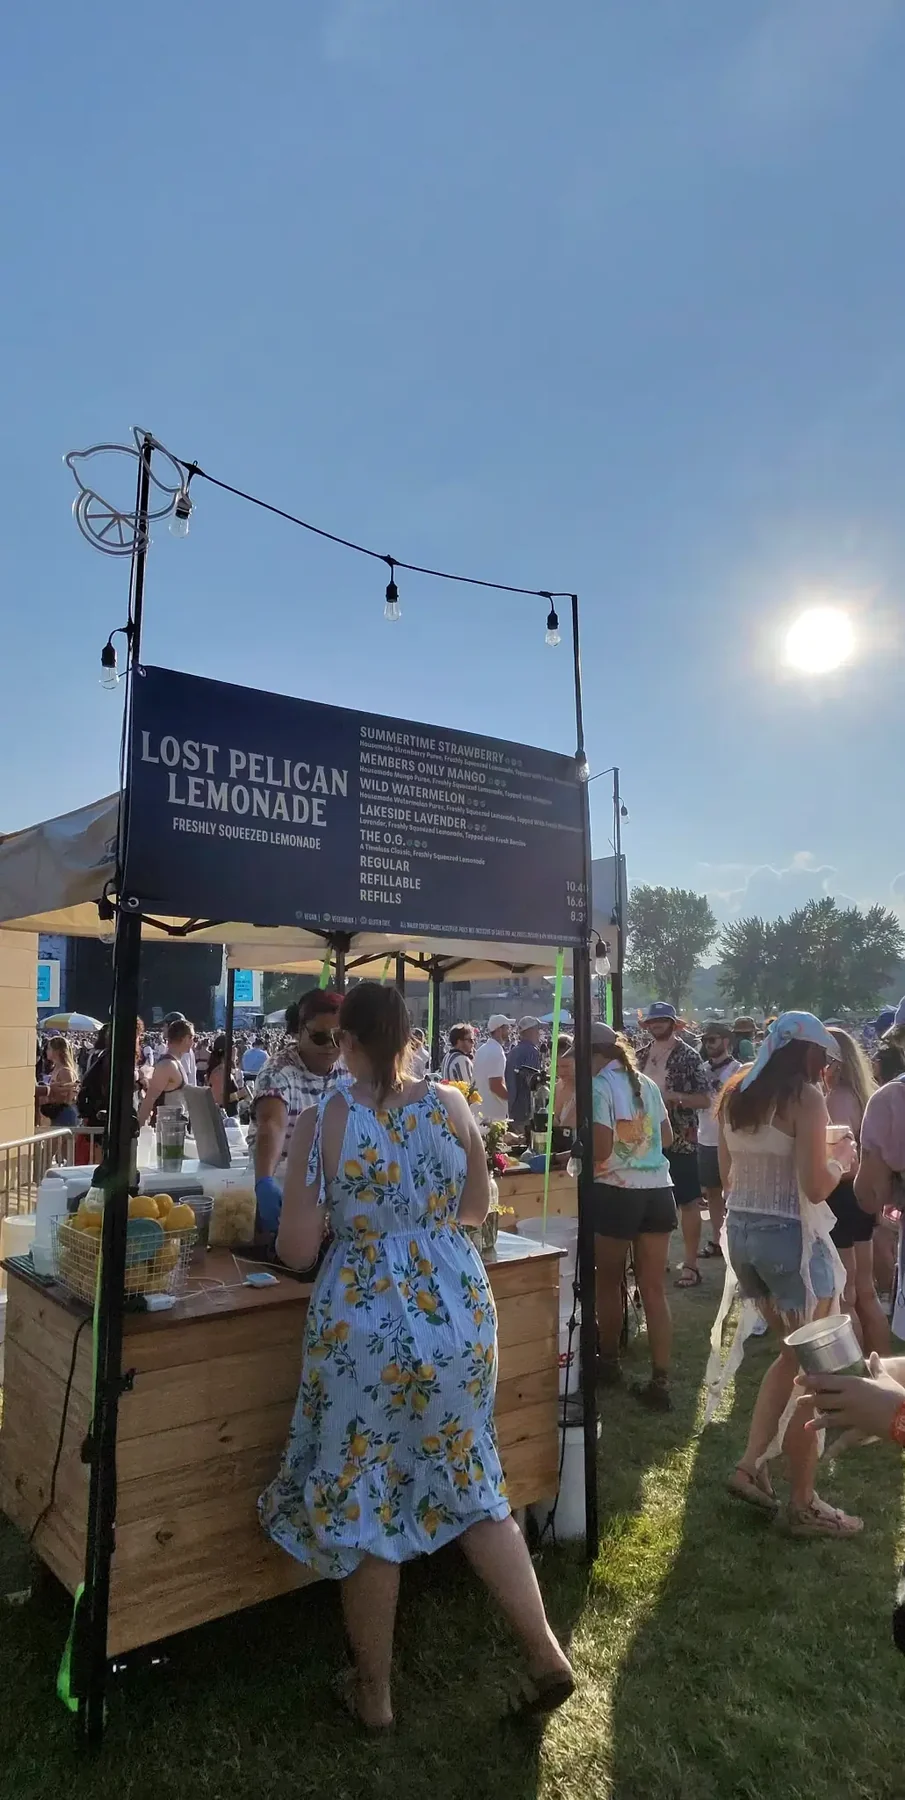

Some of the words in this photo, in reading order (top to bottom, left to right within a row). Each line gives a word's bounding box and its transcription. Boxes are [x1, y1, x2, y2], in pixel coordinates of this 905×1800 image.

[360, 726, 436, 750] SUMMERTIME
[438, 740, 504, 764] STRAWBERRY
[140, 730, 219, 775] LOST
[228, 748, 349, 797] PELICAN
[360, 751, 415, 772] MEMBERS
[417, 762, 445, 777] ONLY
[447, 767, 486, 784] MANGO
[168, 772, 327, 827] LEMONADE
[360, 777, 389, 792] WILD
[391, 782, 465, 805] WATERMELON
[360, 803, 411, 822] LAKESIDE
[414, 811, 467, 830] LAVENDER
[173, 817, 216, 836] FRESHLY
[218, 824, 268, 843] SQUEEZED
[270, 832, 321, 850] LEMONADE
[359, 829, 381, 844] THE
[383, 831, 406, 847] O.G.
[359, 843, 364, 851] A
[413, 850, 433, 860] Freshly
[360, 855, 410, 872] REGULAR
[360, 872, 421, 890] REFILLABLE
[360, 889, 402, 904] REFILLS
